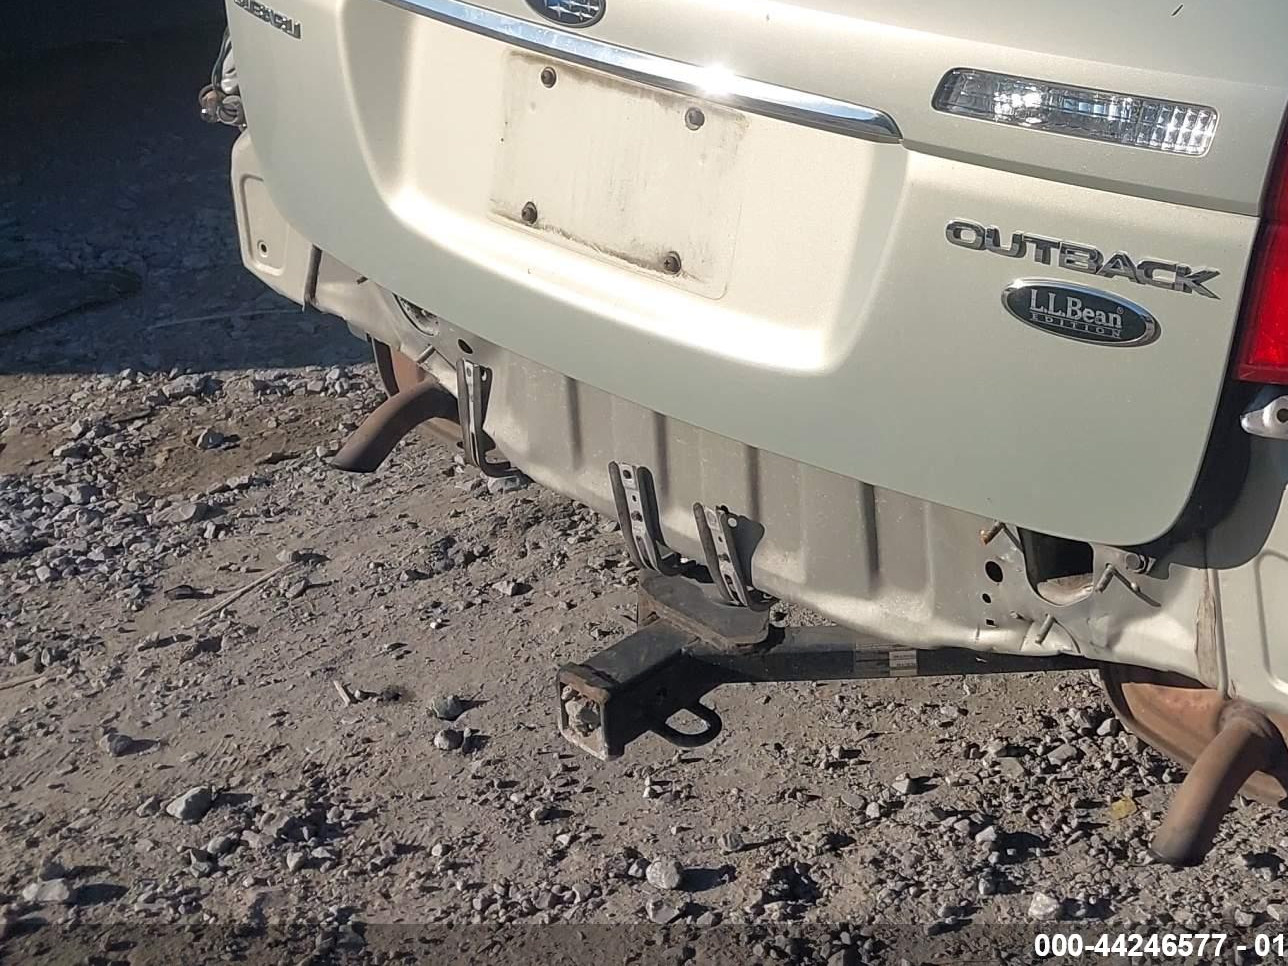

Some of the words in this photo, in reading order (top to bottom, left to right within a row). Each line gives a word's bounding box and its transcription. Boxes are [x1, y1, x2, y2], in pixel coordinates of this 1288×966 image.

[945, 217, 1221, 300] OUTBACK
[1029, 288, 1123, 329] L.L.Bean
[1030, 312, 1122, 339] EDITION
